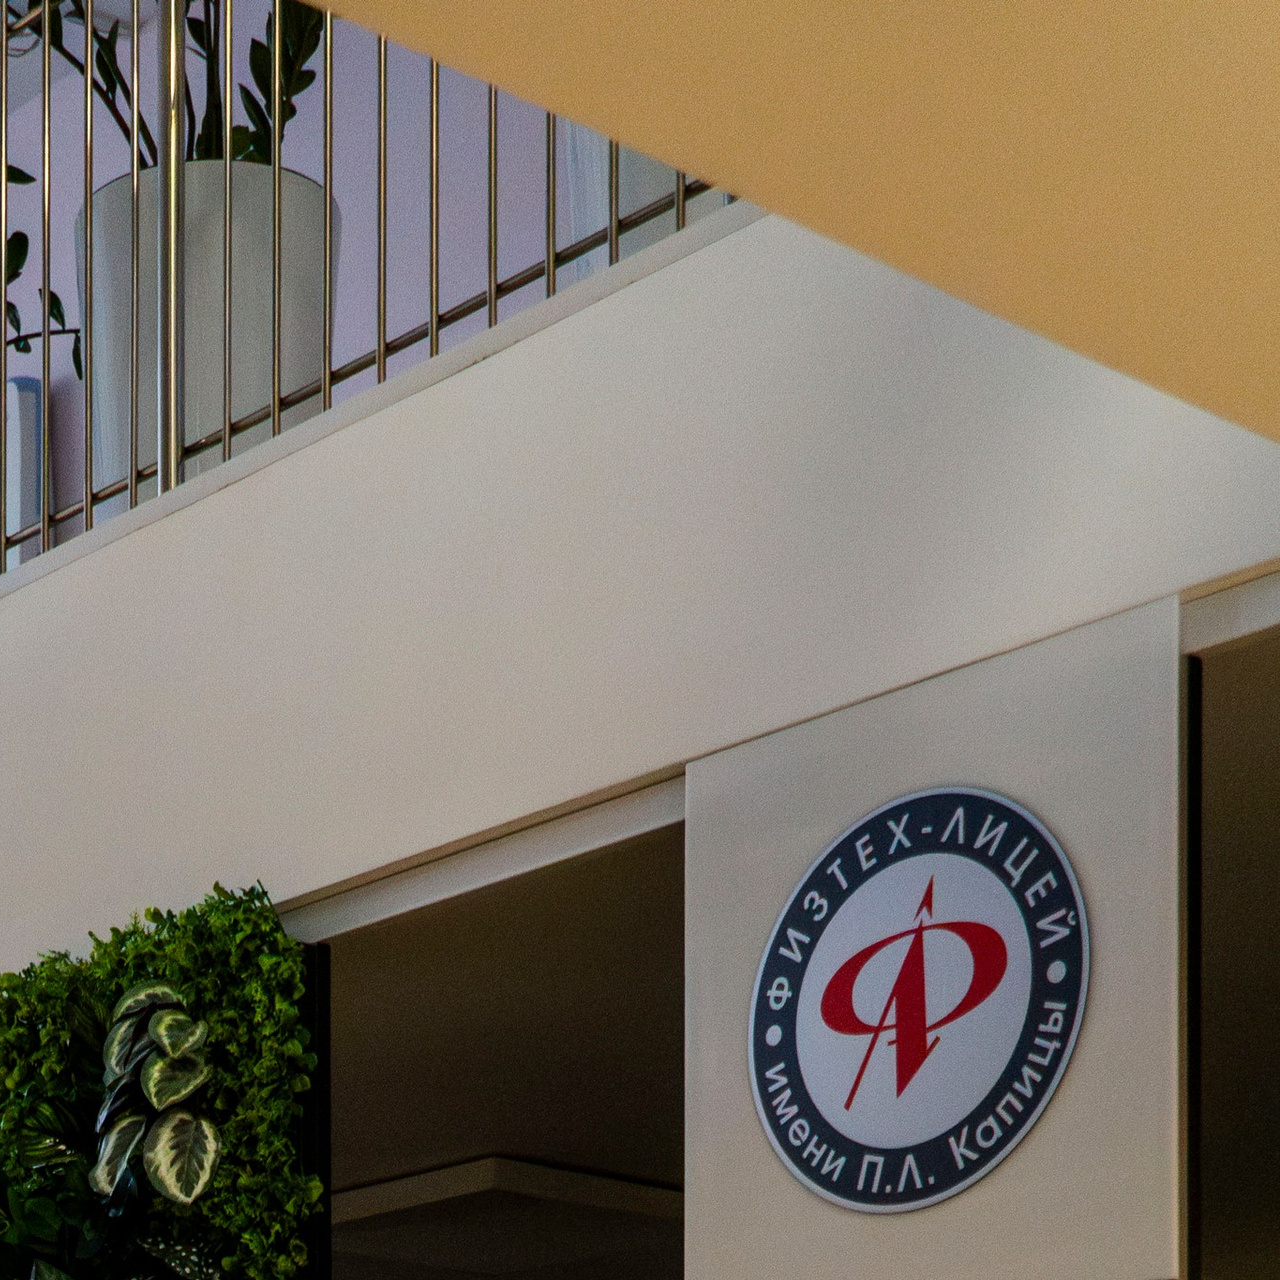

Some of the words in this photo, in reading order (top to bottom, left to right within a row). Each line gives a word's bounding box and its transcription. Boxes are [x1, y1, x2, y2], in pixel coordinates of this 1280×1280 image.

[766, 806, 1076, 1010] ФИЗТЕХ-ЛИЦЕЙ
[765, 1062, 846, 1182] имени
[857, 1153, 935, 1194] П.Л.
[947, 1001, 1067, 1169] Капицы
